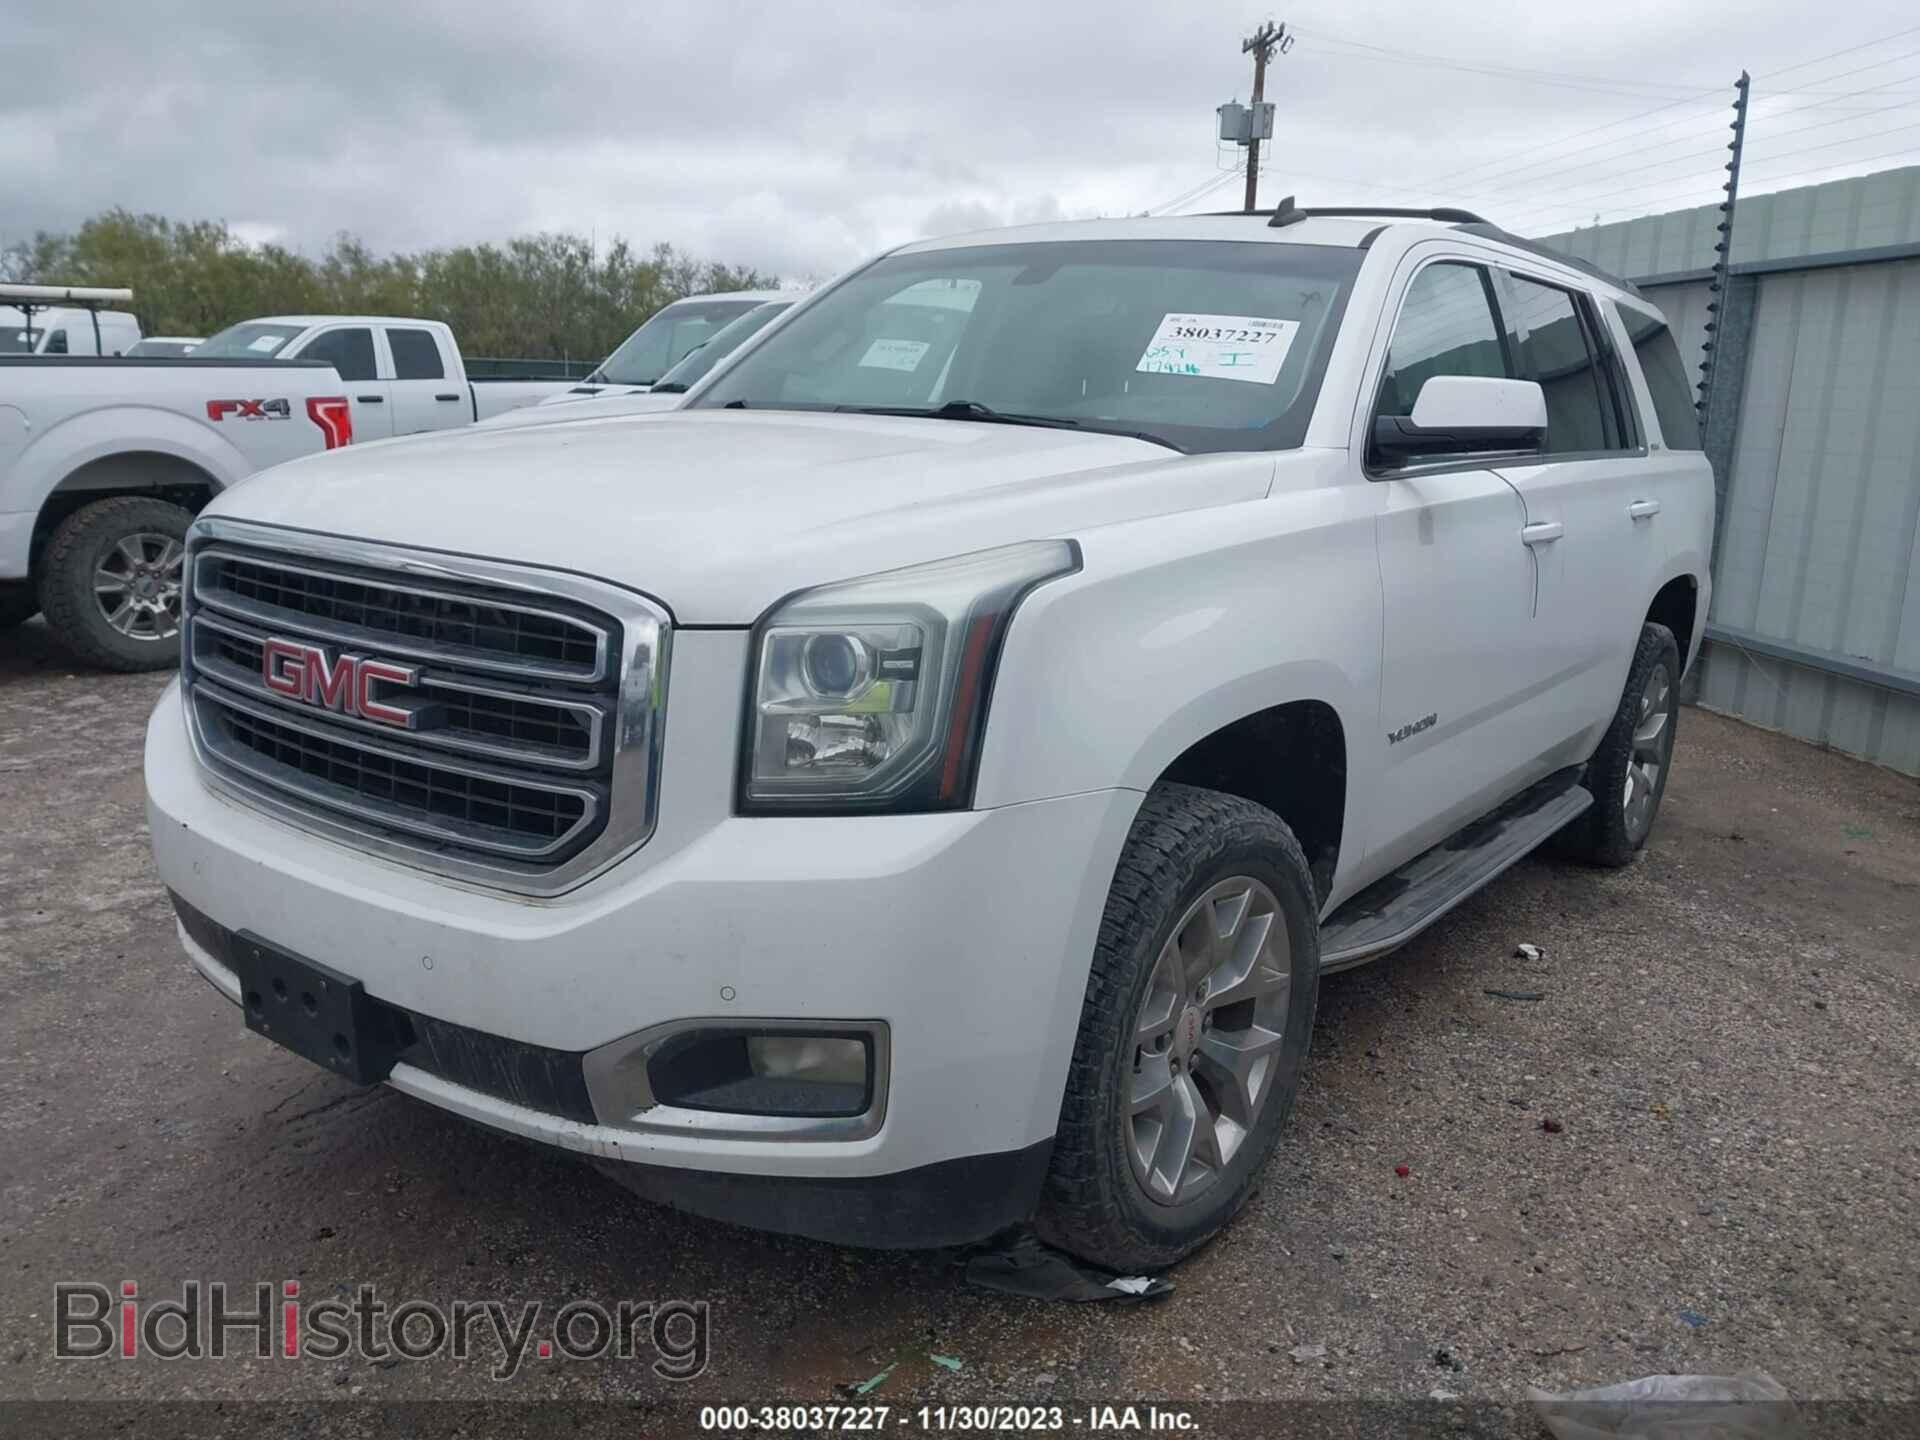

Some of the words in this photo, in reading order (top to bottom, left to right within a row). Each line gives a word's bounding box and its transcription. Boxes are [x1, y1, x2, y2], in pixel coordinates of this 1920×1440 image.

[1169, 327, 1277, 344] 38037227
[207, 398, 291, 422] FX4
[262, 637, 419, 729] GMC
